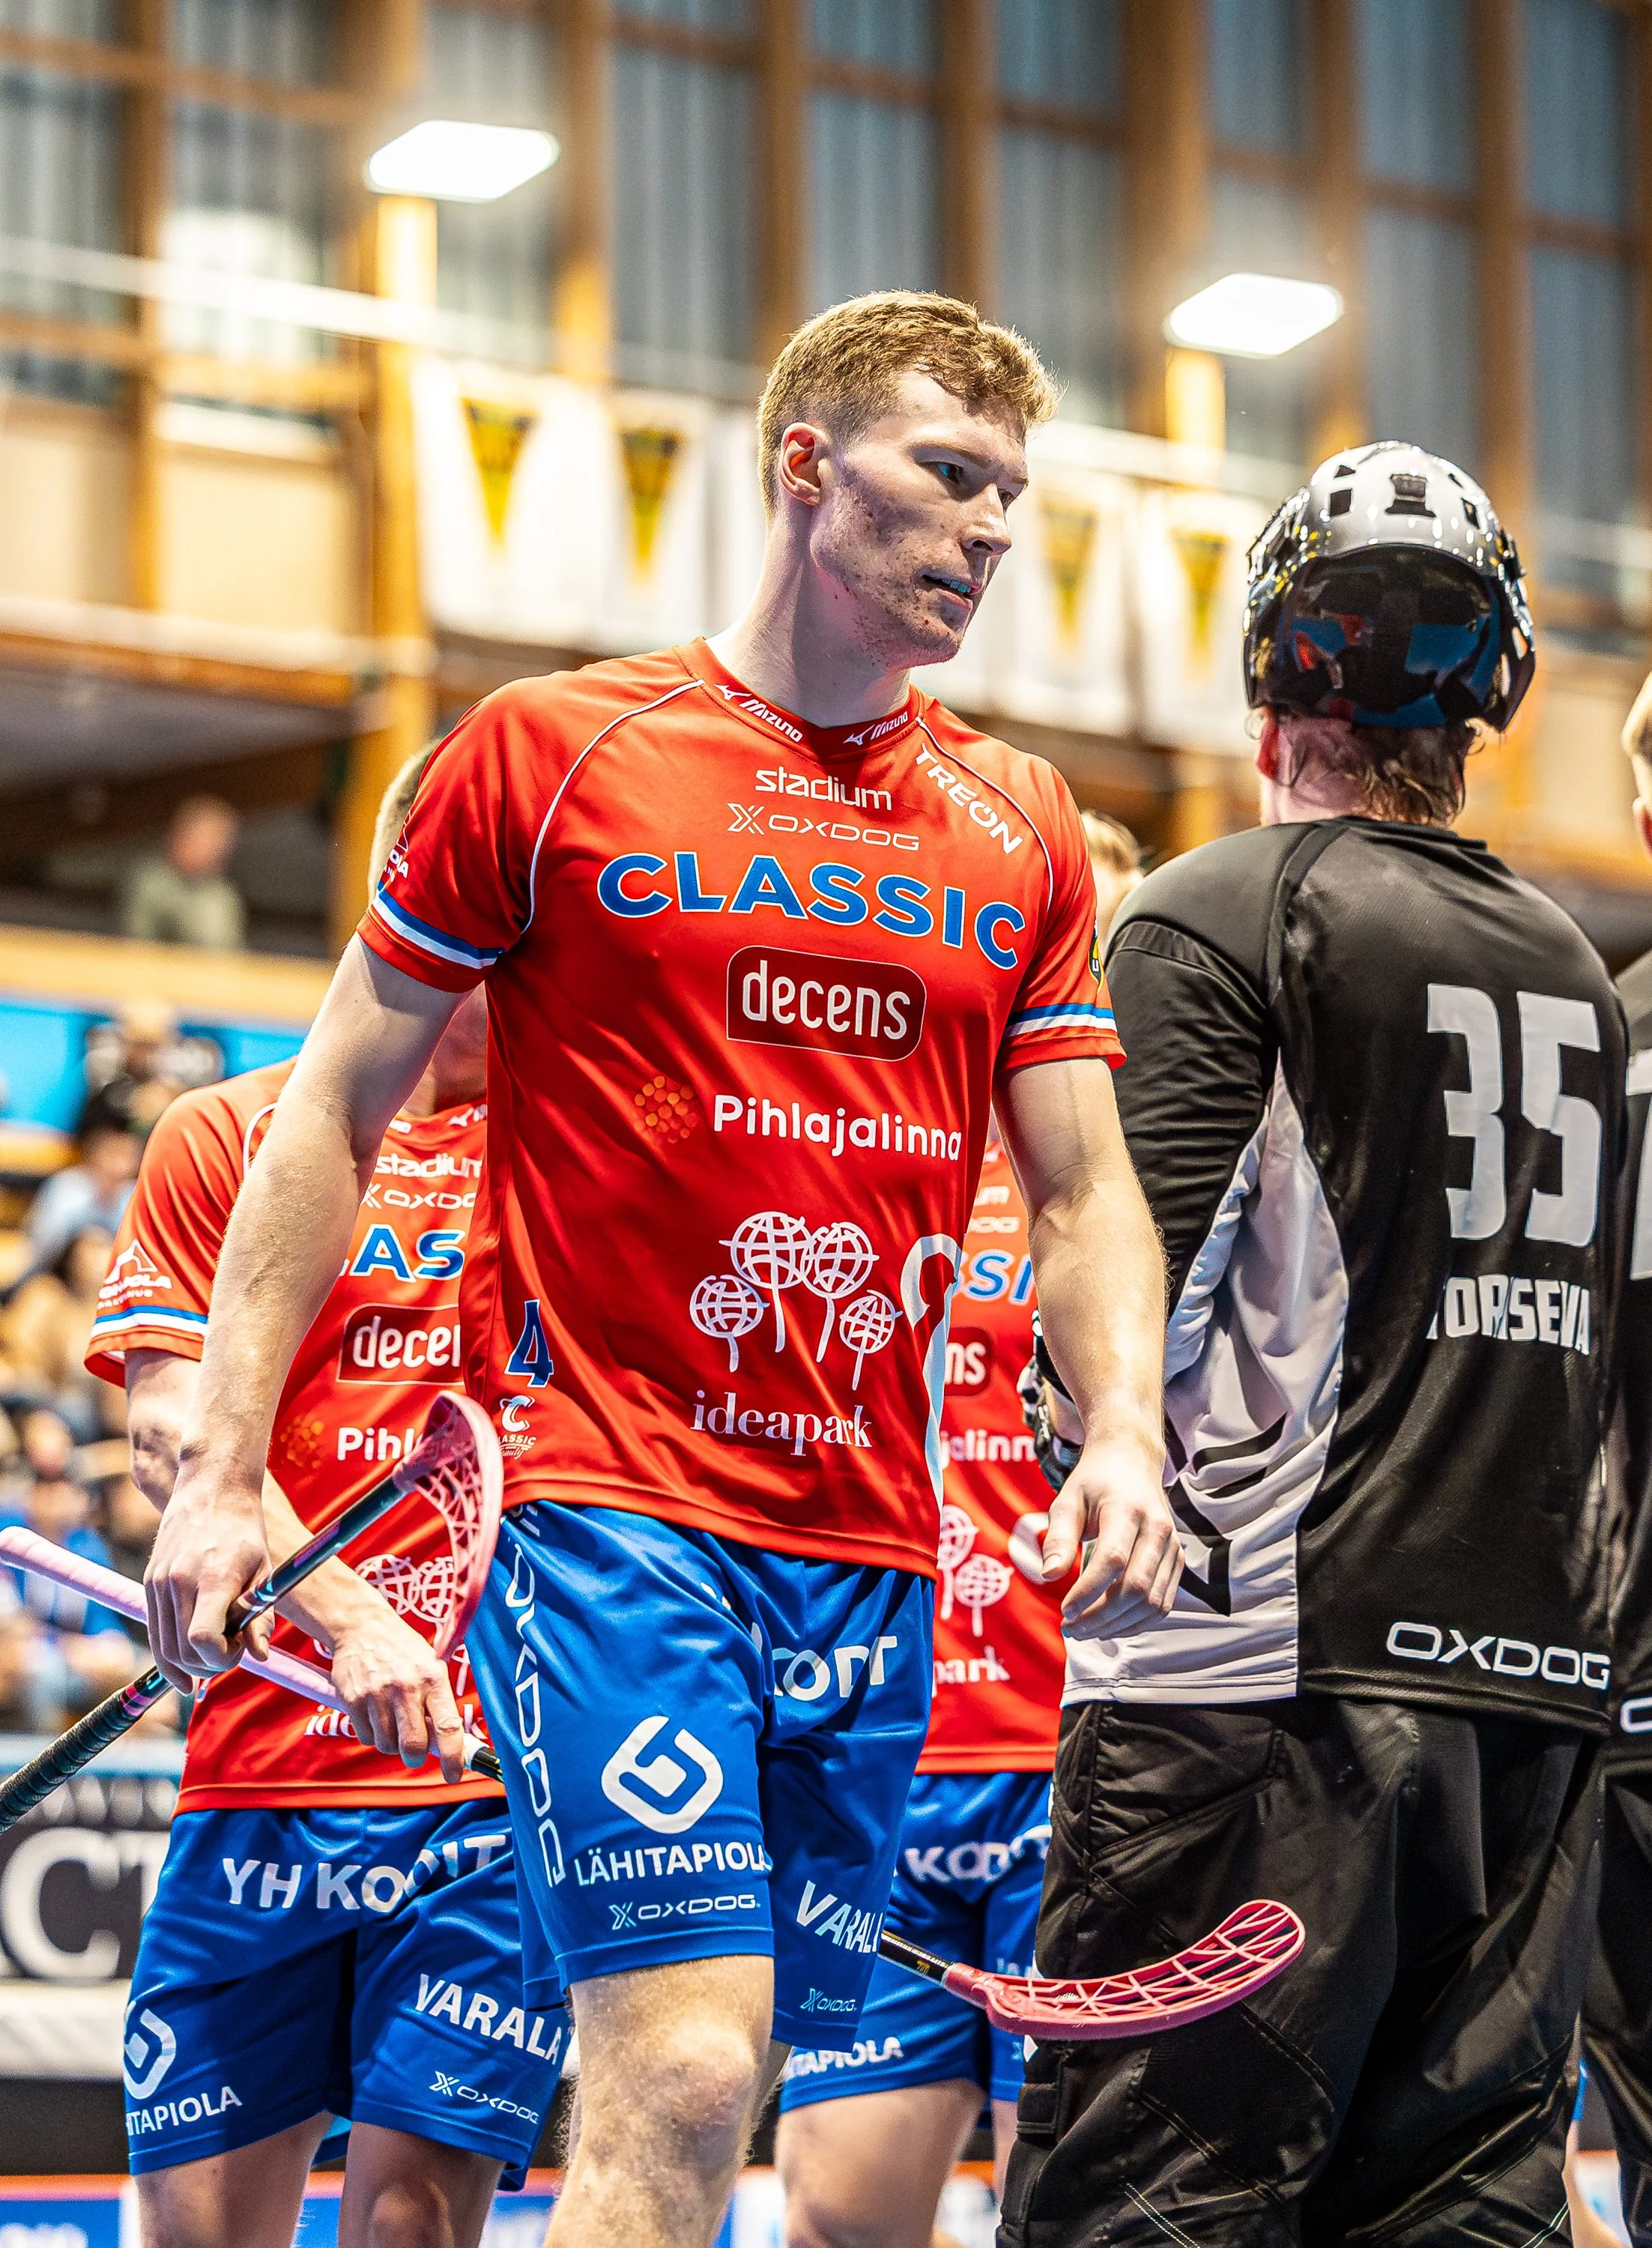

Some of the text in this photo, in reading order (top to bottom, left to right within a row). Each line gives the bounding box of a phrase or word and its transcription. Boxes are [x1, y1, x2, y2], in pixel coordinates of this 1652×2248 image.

[754, 766, 892, 811] stadium
[916, 743, 1023, 855] TREON
[597, 851, 1026, 970] CLASSIC
[742, 960, 910, 1040] decens
[714, 1094, 961, 1161] Pihlajalinna
[1427, 983, 1603, 1247] 35
[504, 1299, 554, 1389] 4
[337, 1427, 423, 1461] Pihl
[690, 1389, 872, 1457] ideapark
[1387, 1622, 1611, 1690] OXDOG
[223, 1858, 301, 1909] YH
